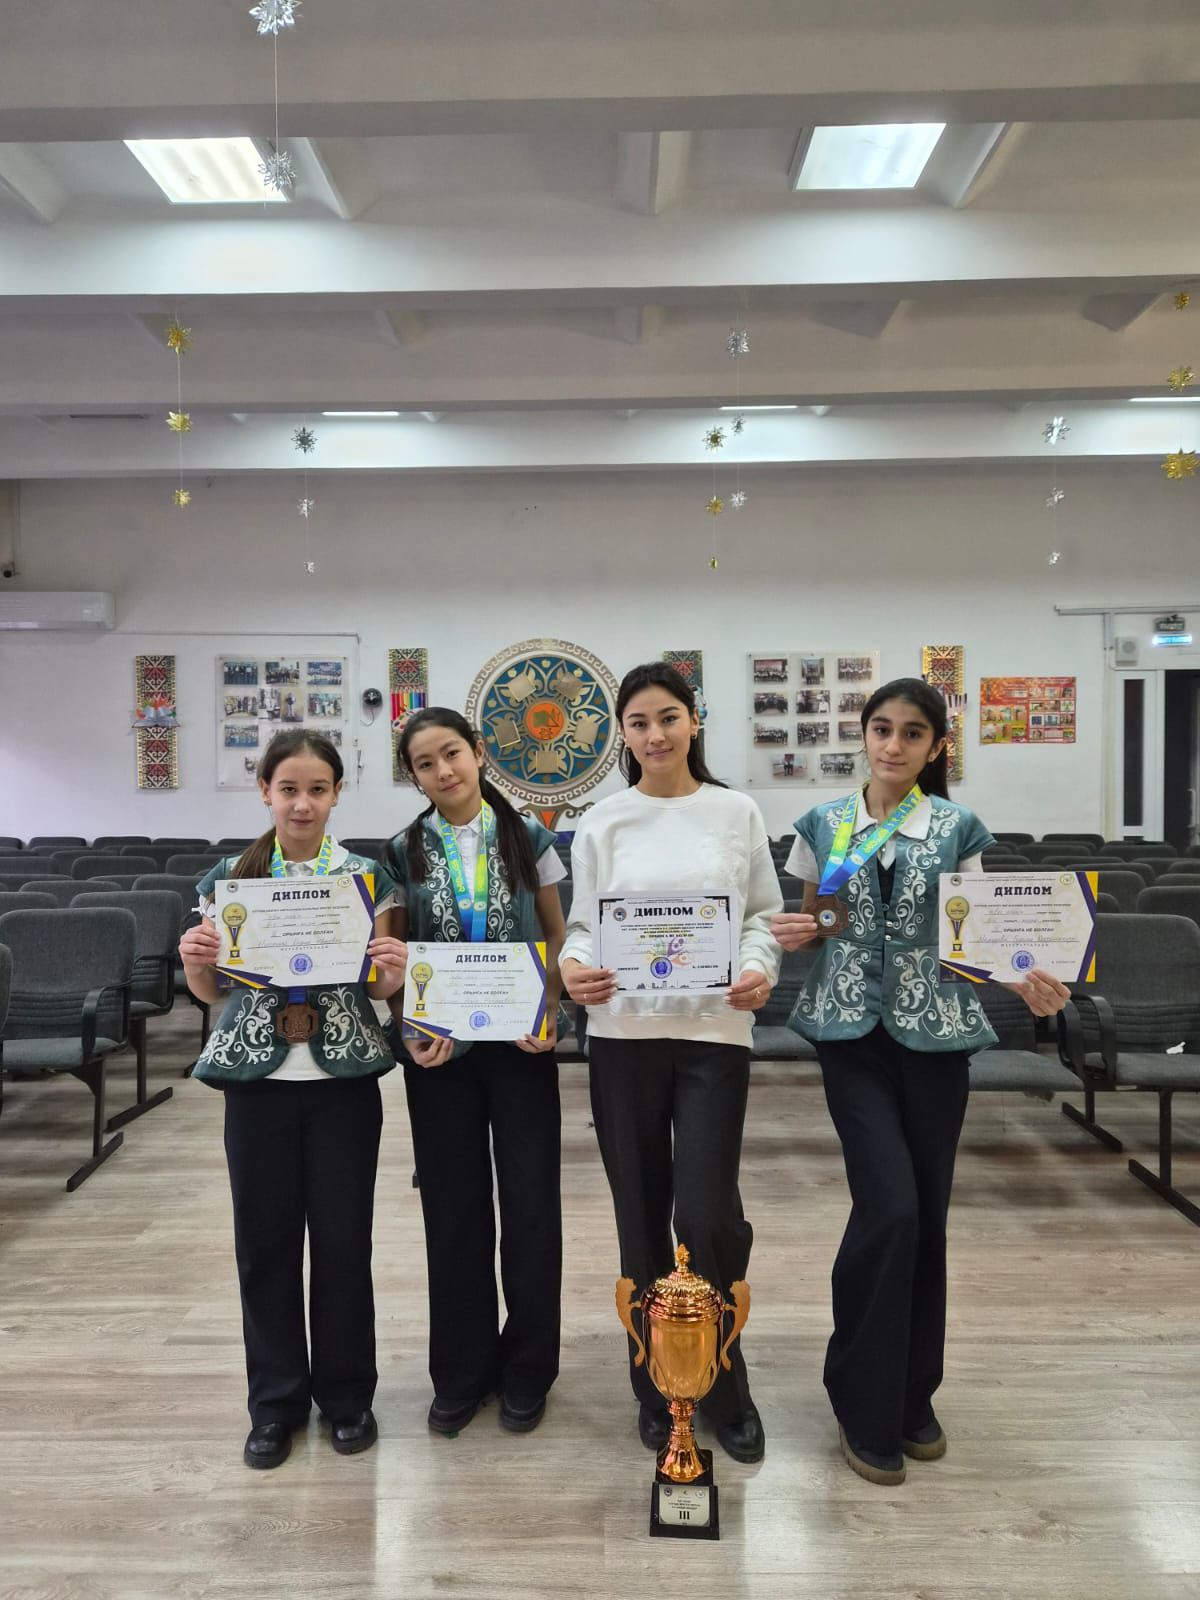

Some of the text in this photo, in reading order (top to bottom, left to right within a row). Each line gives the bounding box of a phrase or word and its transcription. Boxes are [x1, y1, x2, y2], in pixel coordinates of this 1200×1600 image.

[272, 889, 331, 902] ДИПЛОМ
[994, 886, 1053, 898] ДИПЛОМ
[633, 906, 694, 918] ДИПЛОМ
[455, 954, 507, 964] ДИПЛОМ
[679, 1510, 690, 1520] III
